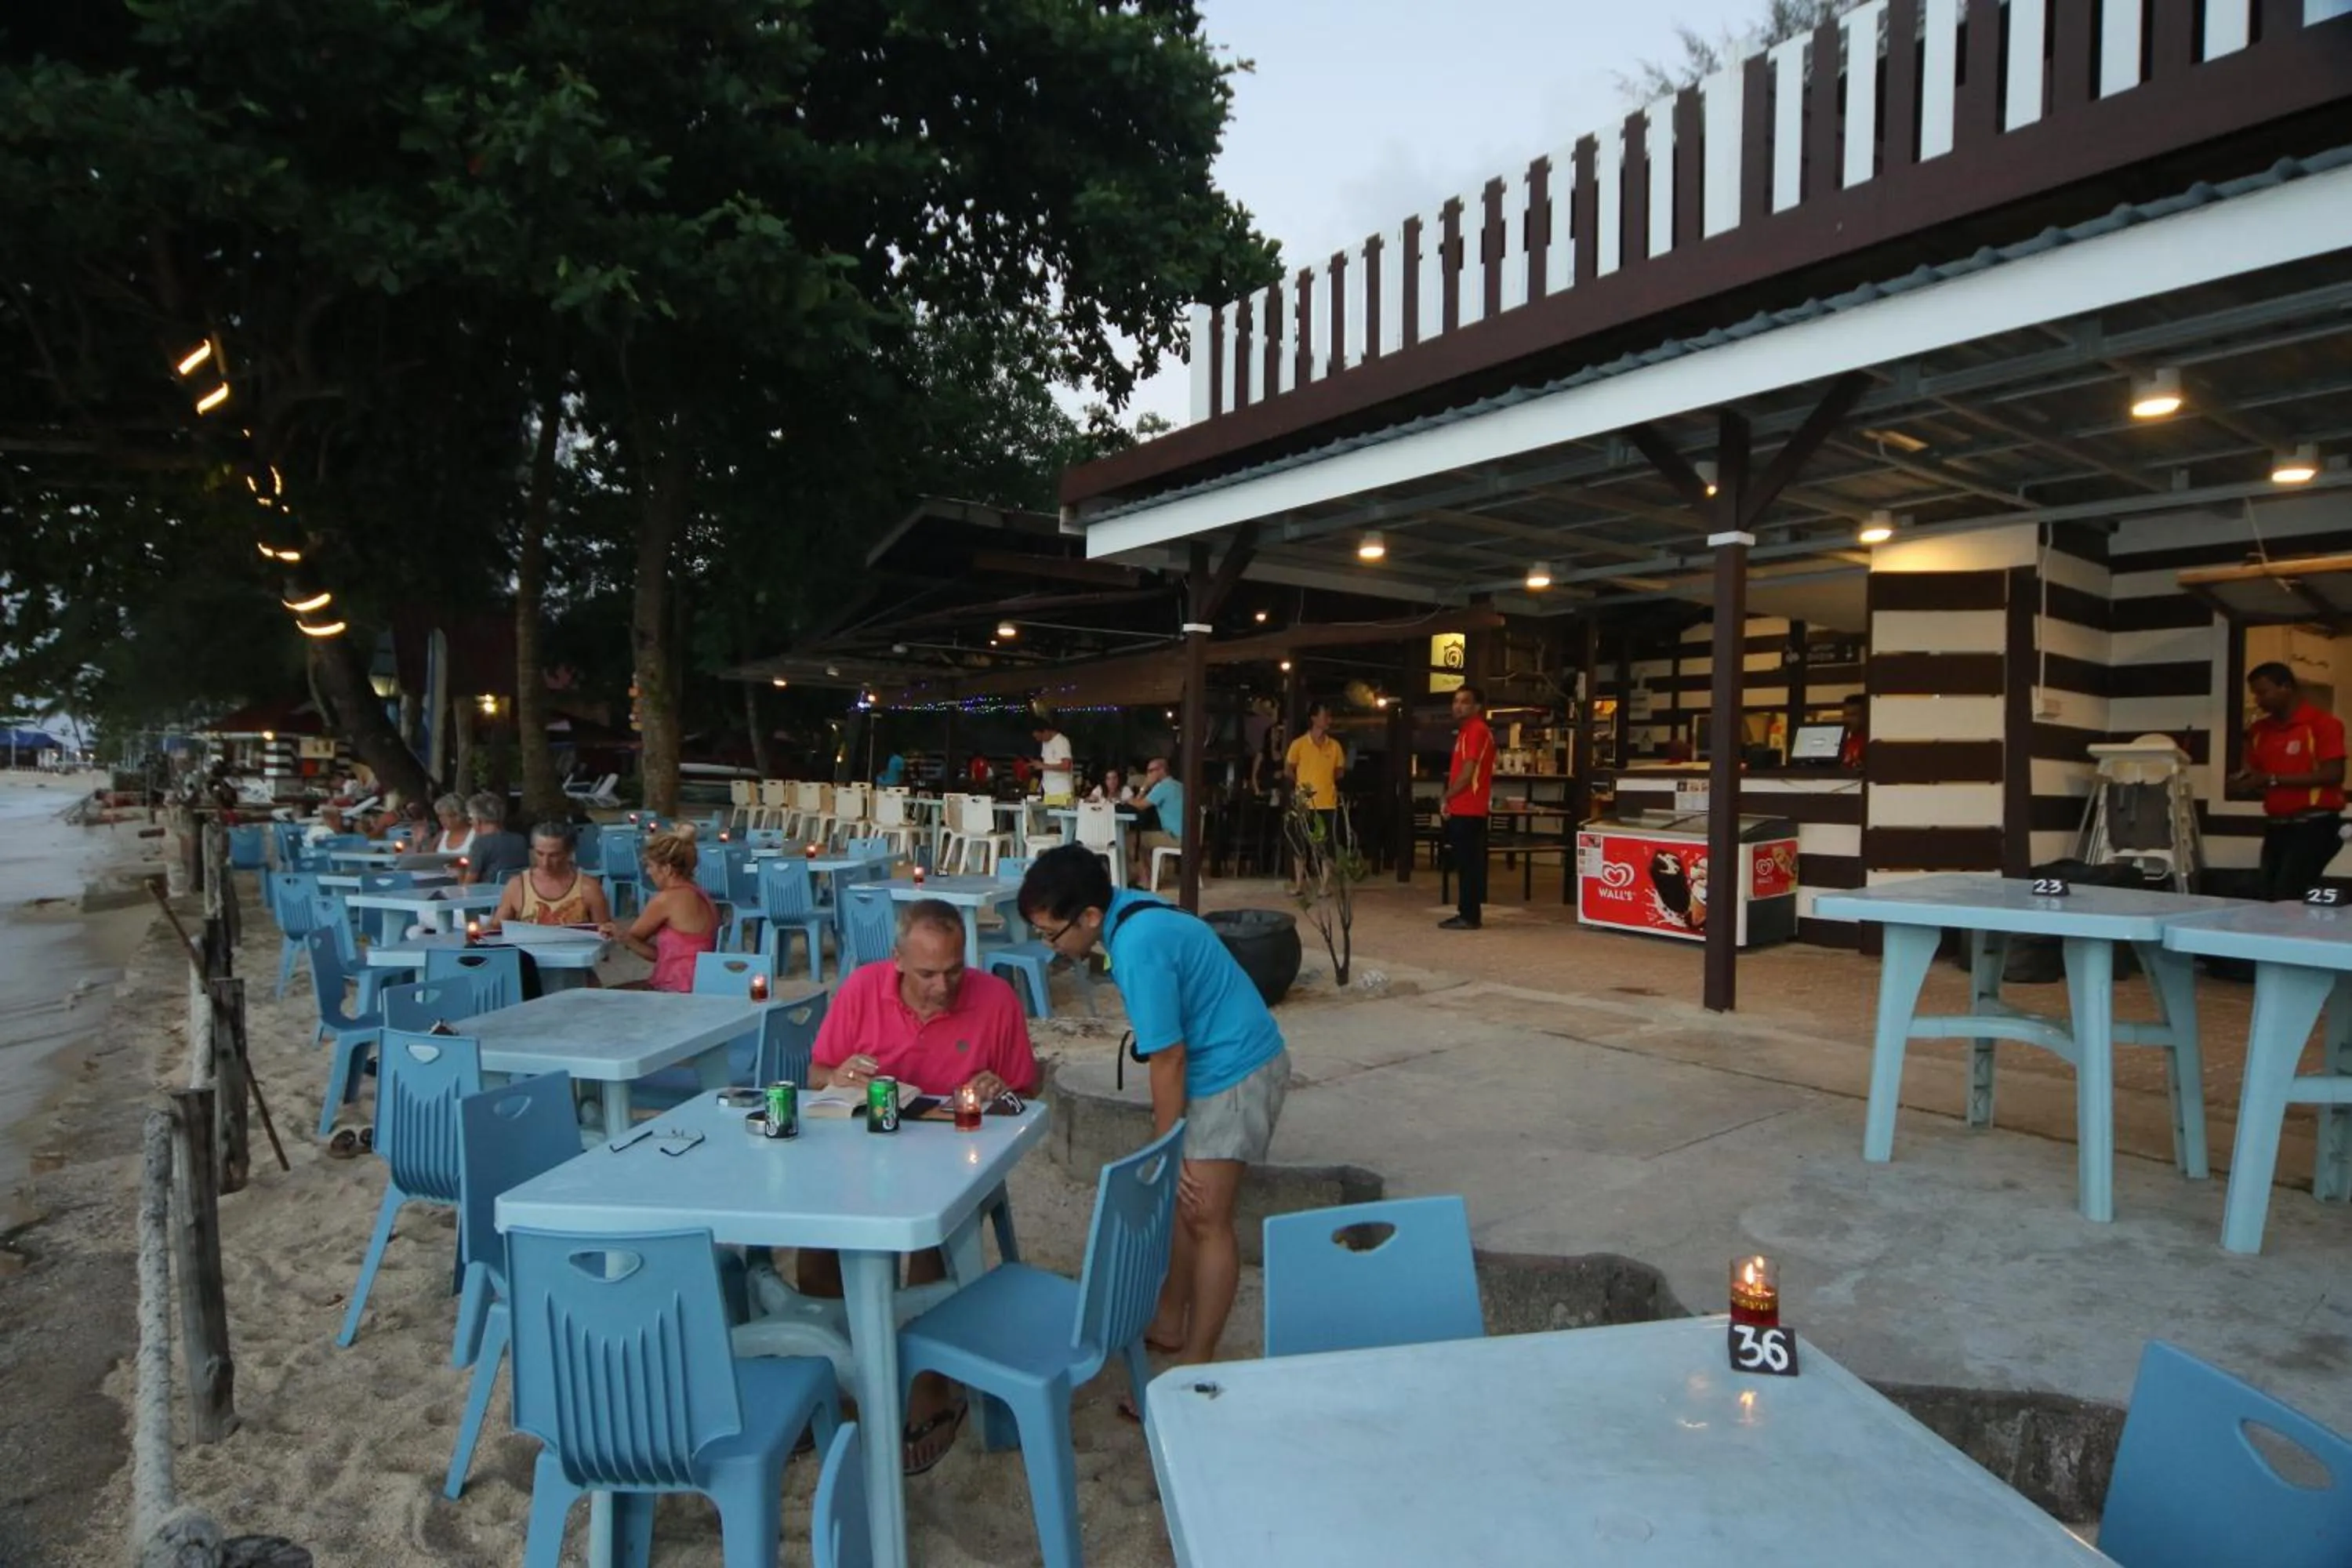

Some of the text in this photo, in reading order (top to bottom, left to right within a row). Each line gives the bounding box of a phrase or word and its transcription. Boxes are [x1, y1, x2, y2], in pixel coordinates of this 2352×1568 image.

[2034, 879, 2063, 893] 23
[1598, 887, 1633, 901] WALL'S
[2307, 888, 2338, 902] 25
[1734, 1325, 1788, 1371] 36
